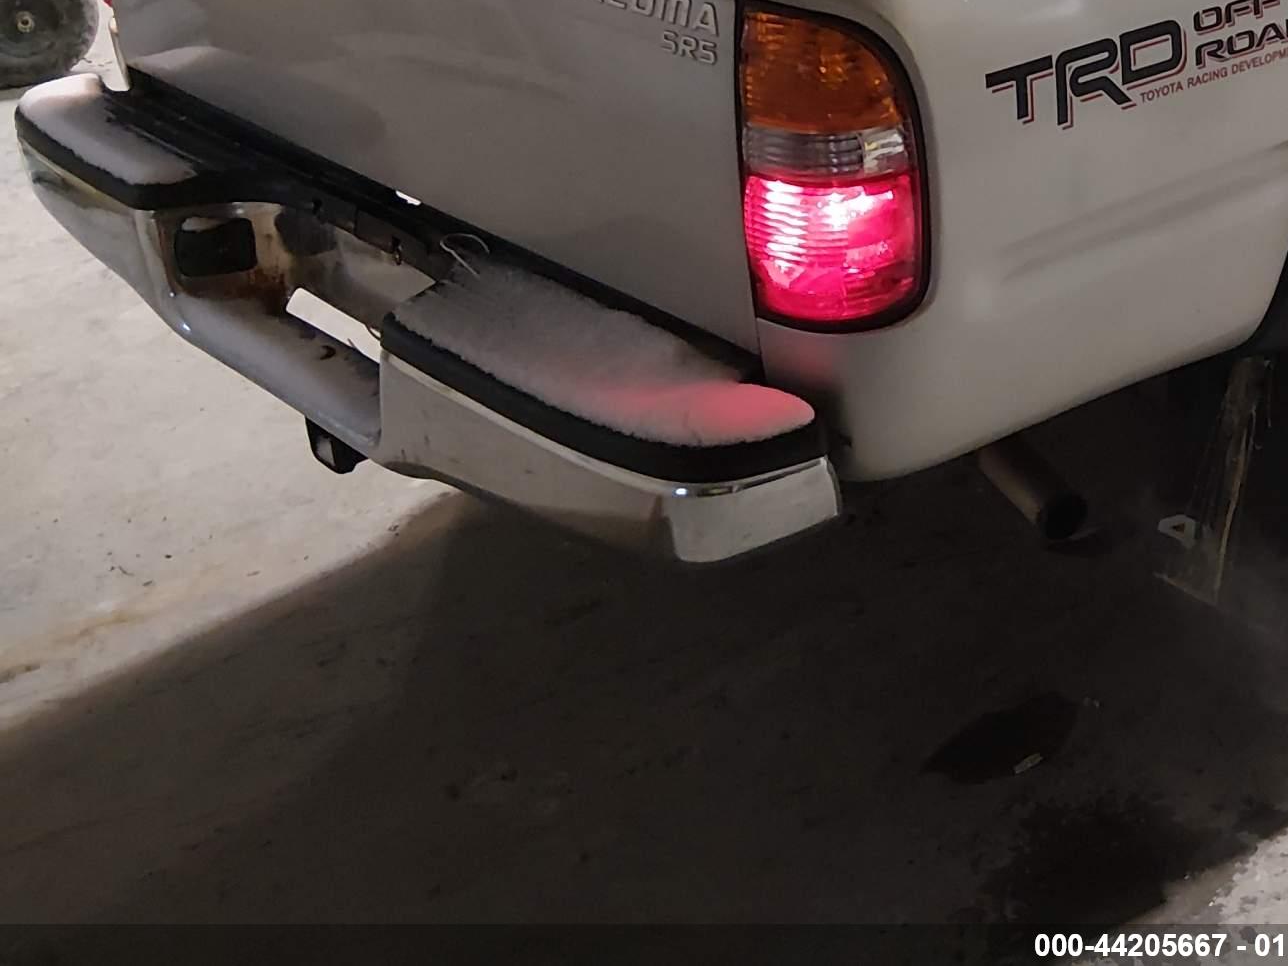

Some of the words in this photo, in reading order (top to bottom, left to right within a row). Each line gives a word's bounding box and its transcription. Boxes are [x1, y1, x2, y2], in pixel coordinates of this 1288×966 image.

[661, 30, 717, 65] SR5
[985, 20, 1187, 130] TRD
[1140, 82, 1184, 103] TOYOTA
[1187, 68, 1229, 89] RACING
